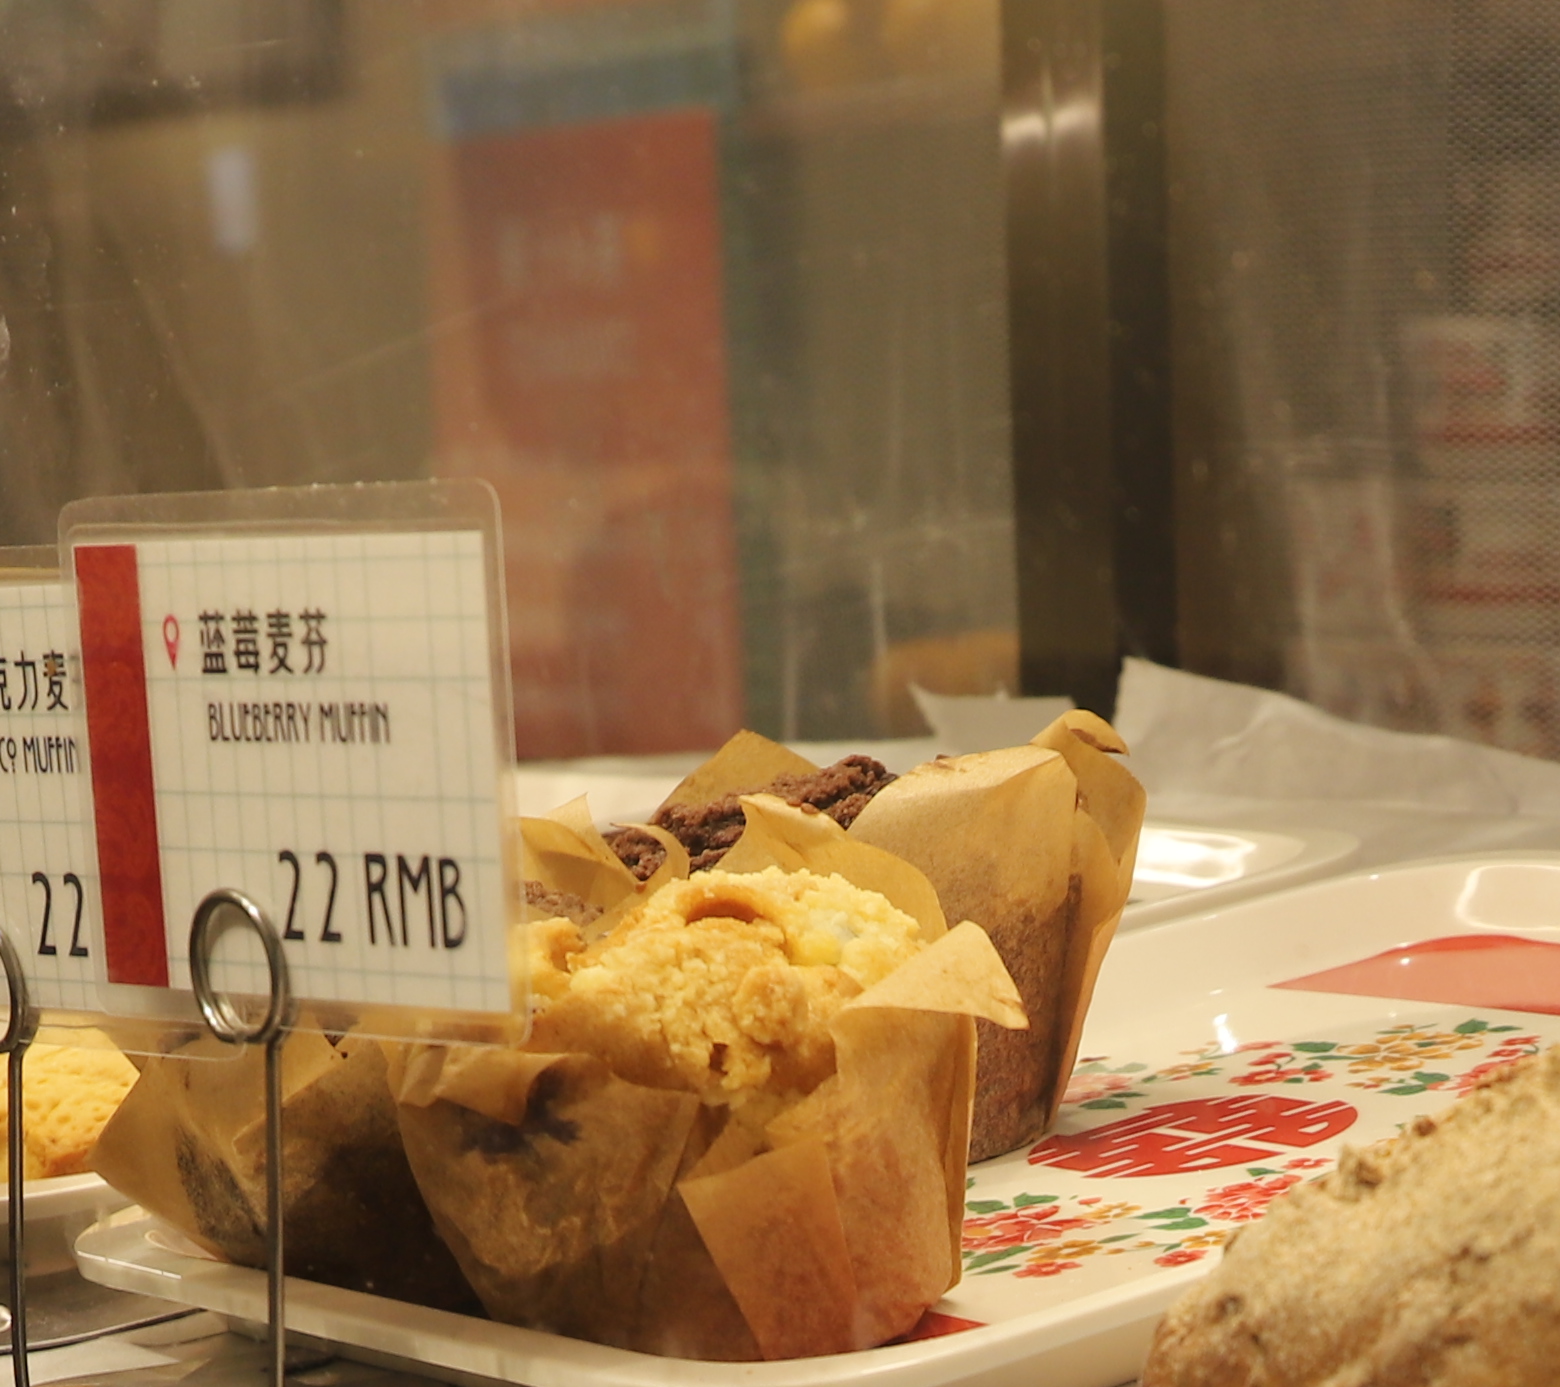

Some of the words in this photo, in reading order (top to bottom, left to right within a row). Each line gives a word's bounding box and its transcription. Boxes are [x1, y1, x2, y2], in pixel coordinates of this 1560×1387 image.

[198, 608, 328, 675] 蓝莓麦芬
[207, 701, 312, 743] BLUEBERRY
[318, 702, 391, 744] MUFFIN
[32, 871, 89, 958] 22
[278, 848, 343, 943] 22
[363, 852, 467, 949] RMB
